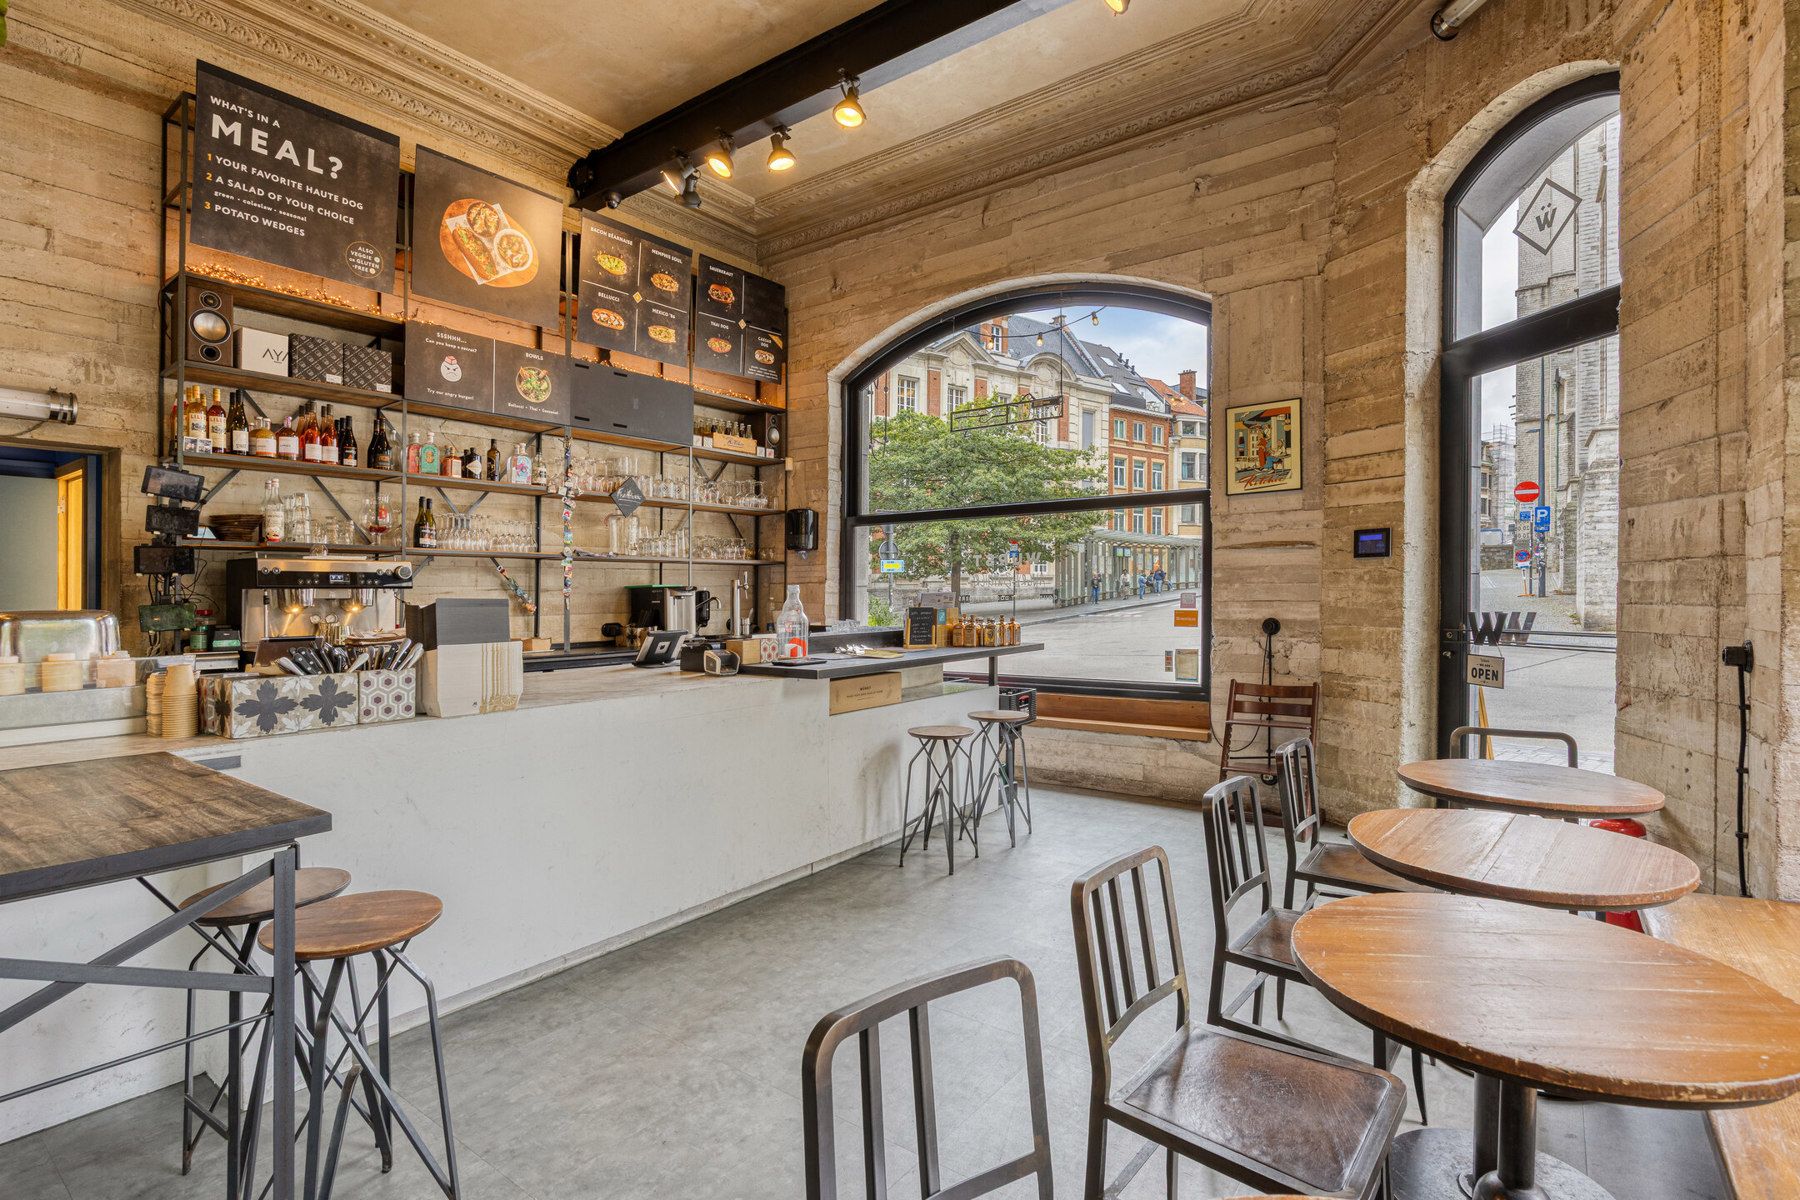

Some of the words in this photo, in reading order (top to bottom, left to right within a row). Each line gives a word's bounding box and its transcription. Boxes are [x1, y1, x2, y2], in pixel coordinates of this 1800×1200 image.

[210, 96, 254, 118] WHAT'S
[257, 114, 269, 124] IN
[272, 120, 280, 128] A
[212, 113, 342, 179] MEAL?
[207, 153, 212, 161] 1
[216, 155, 248, 172] YOUR
[252, 168, 303, 190] FAVORITE
[306, 185, 339, 202] HAUTE
[342, 198, 364, 210] DOG
[206, 172, 212, 180] 2
[216, 176, 224, 184] A
[228, 180, 264, 196] SALAD
[268, 192, 282, 202] OF
[285, 196, 314, 213] YOUR
[318, 208, 354, 225] CHOICE
[214, 191, 234, 200] green
[243, 199, 272, 211] coleslaw
[279, 210, 307, 222] seasonal
[204, 201, 211, 209] 3
[215, 204, 259, 223] POTATO
[262, 217, 305, 236] WEDGES
[590, 226, 607, 237] BACON
[358, 246, 374, 254] ALSO
[356, 259, 379, 269] GLUTEN
[598, 292, 620, 302] BELLUCCI
[526, 353, 544, 361] BOWLS
[1537, 509, 1548, 522] P
[1471, 667, 1498, 681] OPEN
